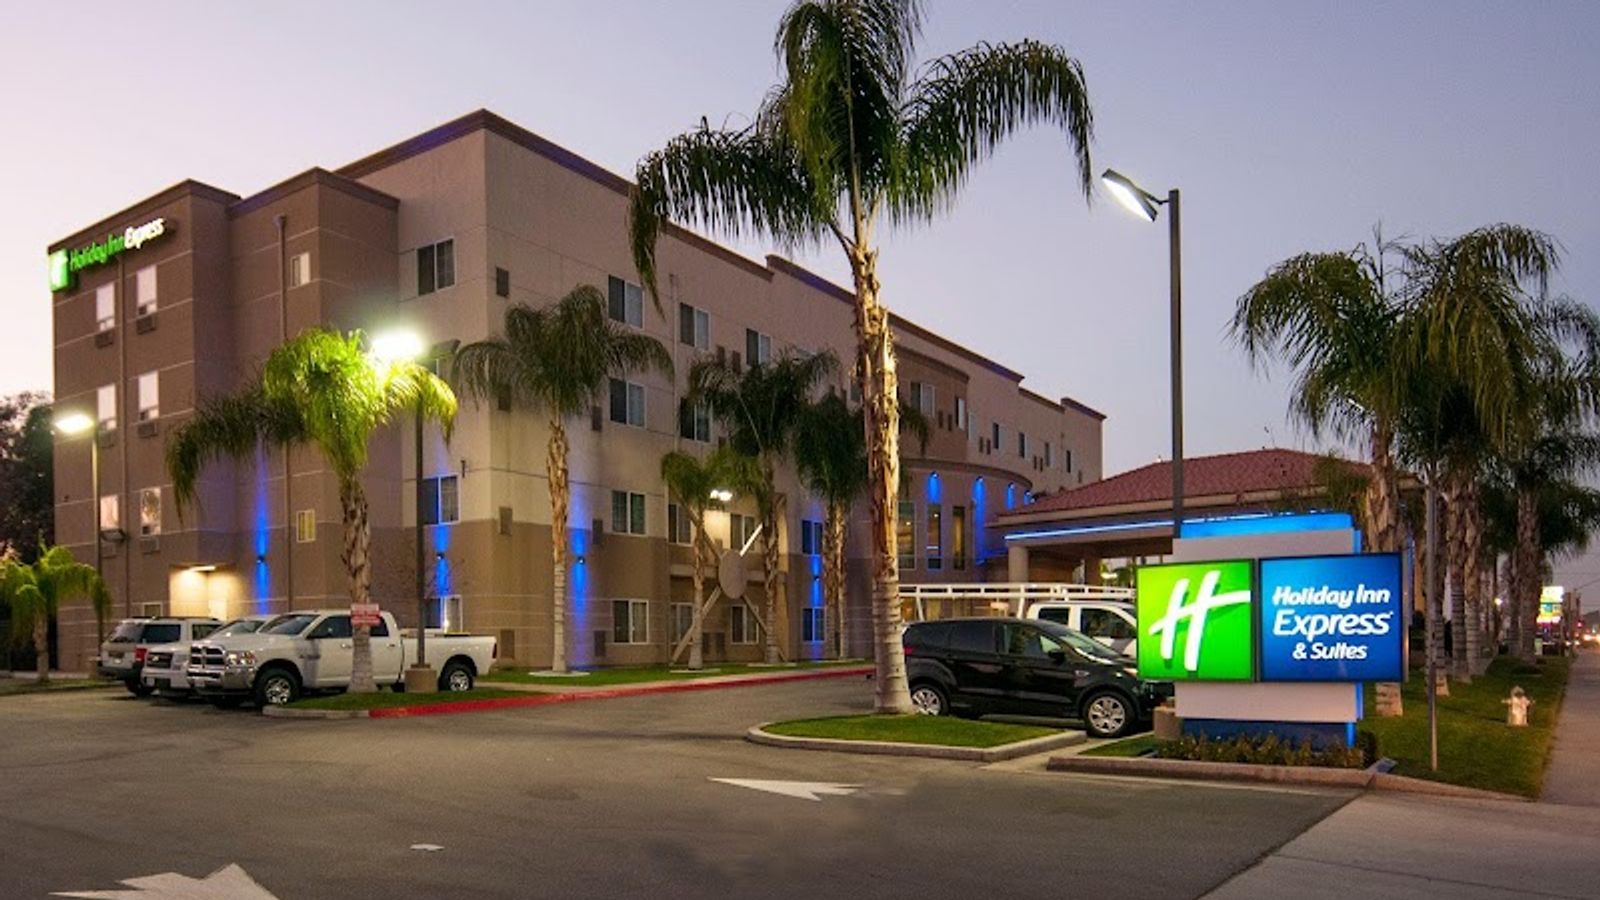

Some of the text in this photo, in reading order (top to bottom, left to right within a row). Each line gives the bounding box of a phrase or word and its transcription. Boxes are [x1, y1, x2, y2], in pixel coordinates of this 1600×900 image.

[70, 218, 165, 271] Holiday Inn Express
[1272, 584, 1391, 609] Holiday Inn
[1148, 570, 1251, 672] H
[1273, 609, 1392, 642] Express
[1292, 642, 1368, 660] & Suites
